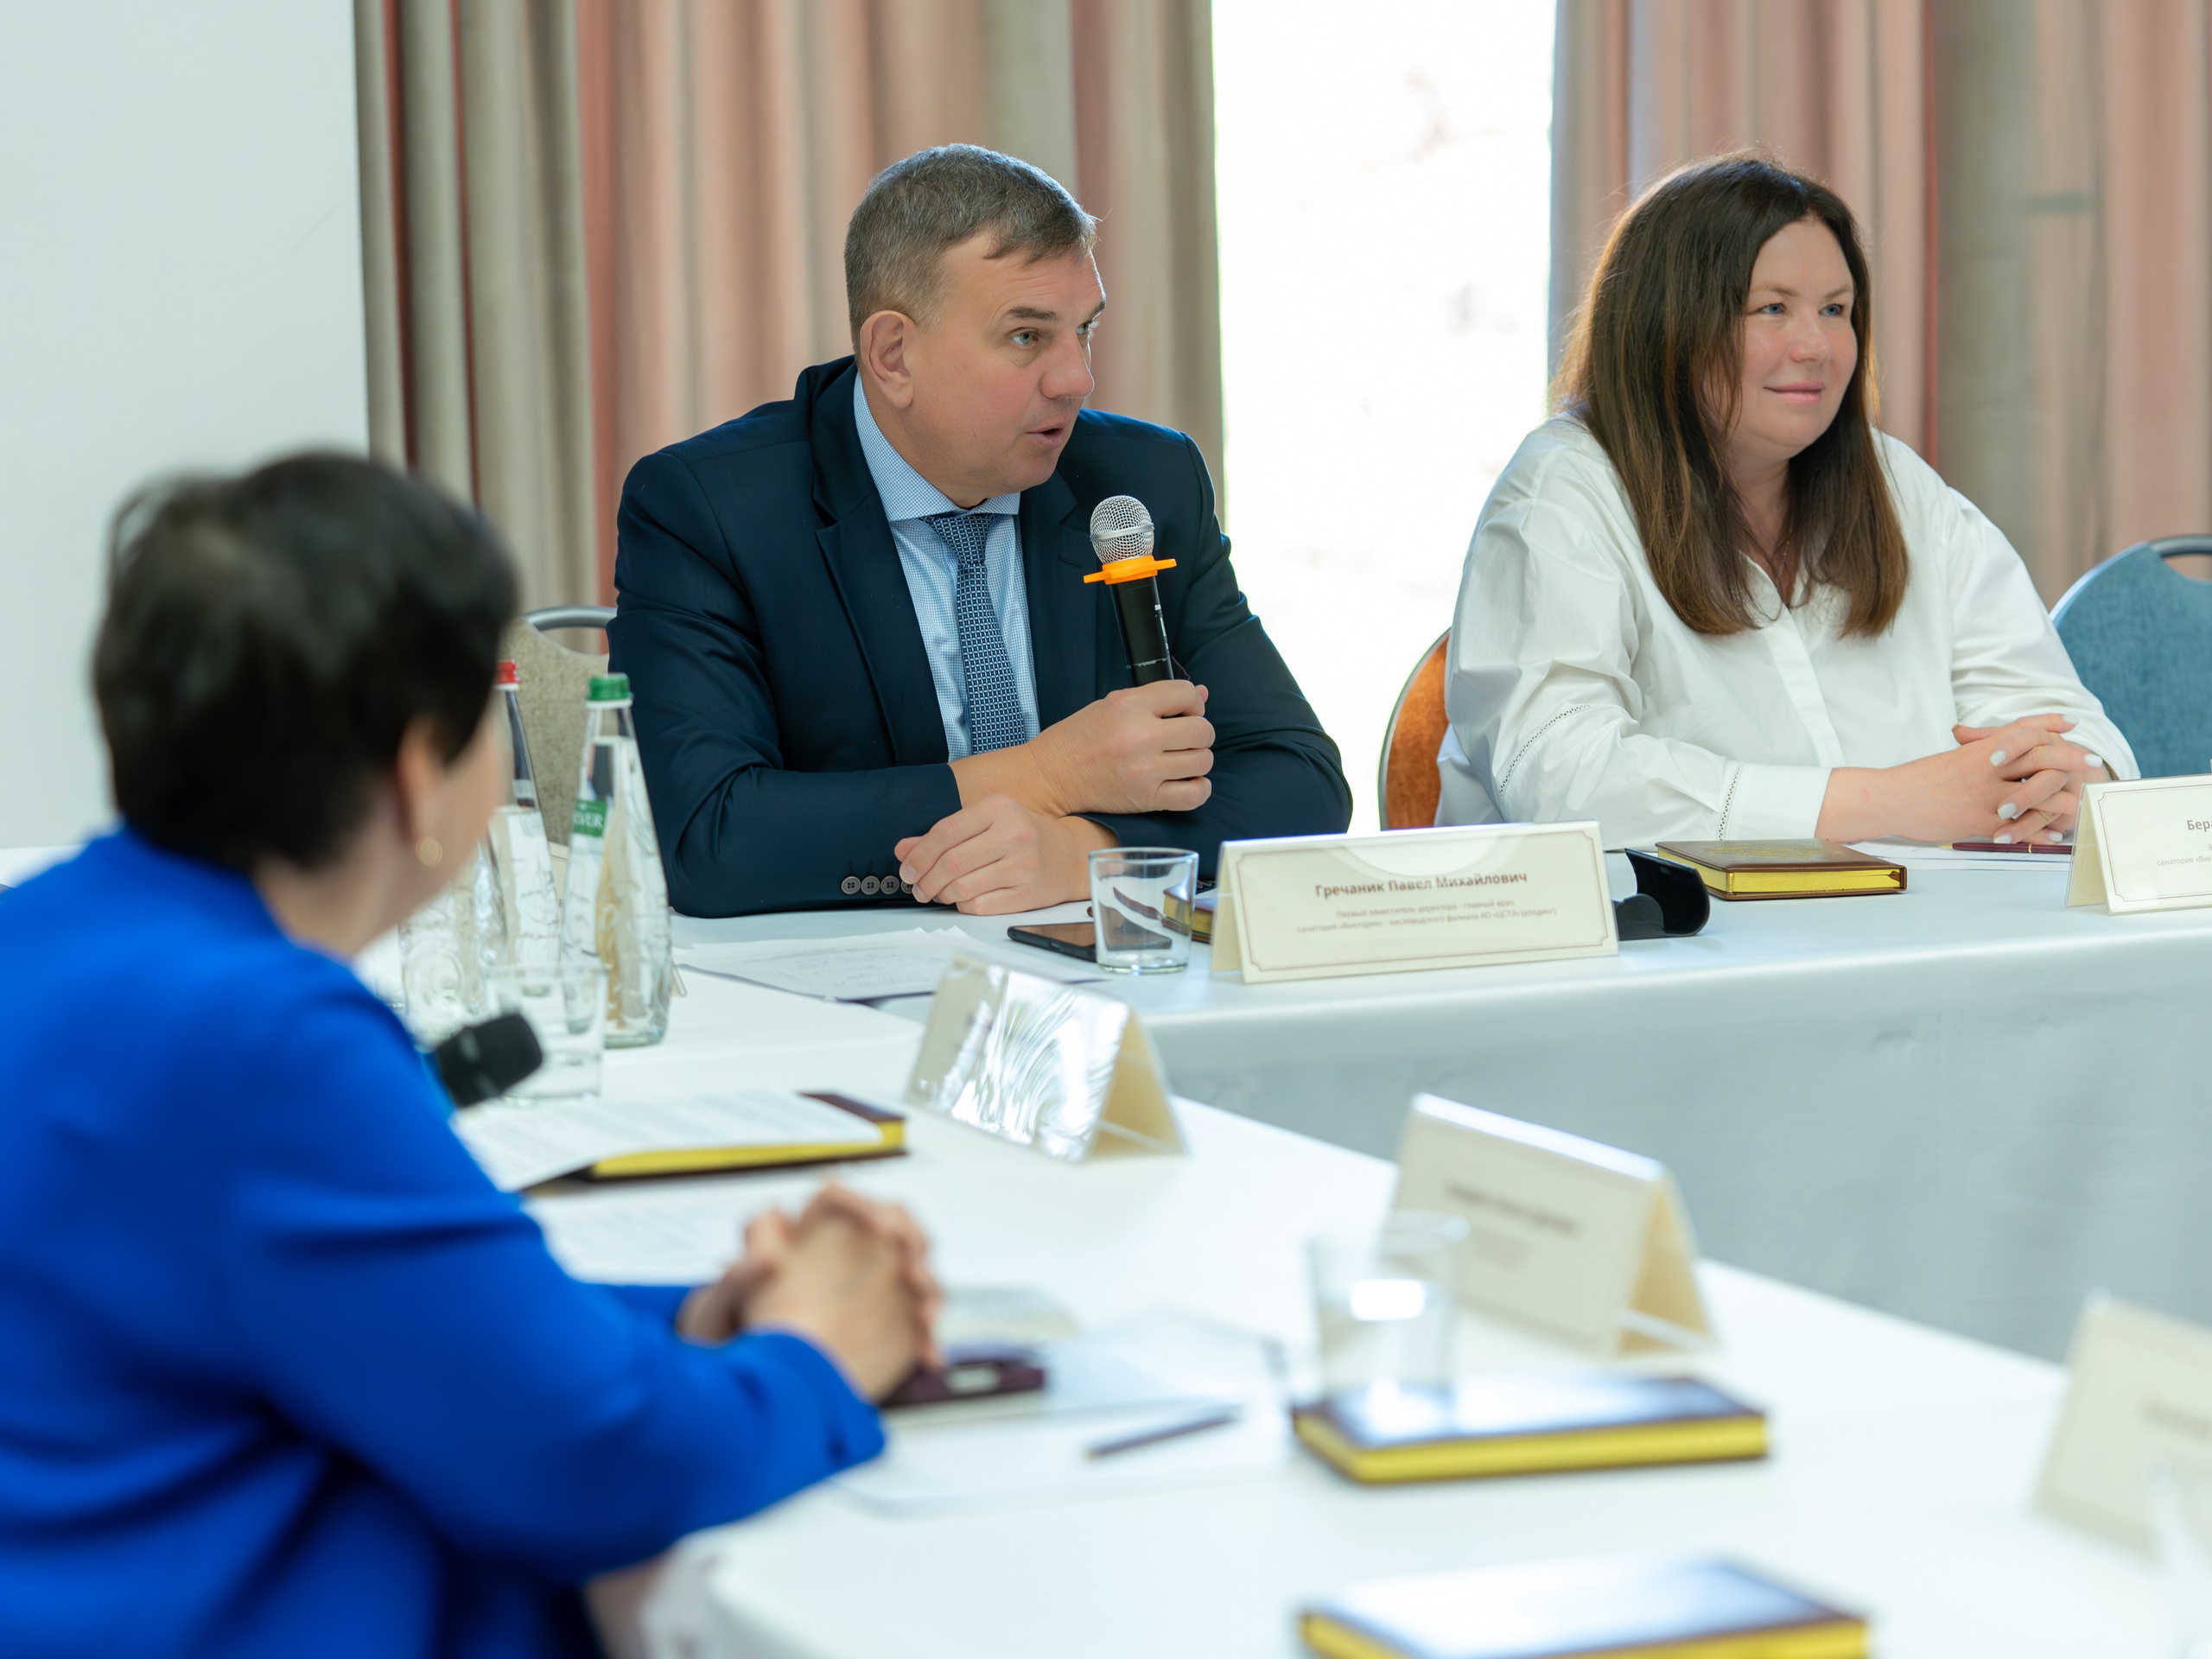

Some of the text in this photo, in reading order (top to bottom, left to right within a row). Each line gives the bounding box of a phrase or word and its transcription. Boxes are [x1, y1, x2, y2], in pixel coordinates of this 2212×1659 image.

[2186, 819, 2212, 832] Бер
[2157, 855, 2212, 866] санатория «Вик
[1315, 873, 1528, 899] Гречаник Павел Михайлович
[1337, 908, 1368, 918] Первый
[1370, 906, 1416, 916] заместитель
[1418, 903, 1458, 913] директора
[1464, 899, 1496, 909] главный
[1497, 899, 1515, 908] врач
[1298, 924, 1338, 933] санатория
[1339, 920, 1383, 930] «Виктория»
[1389, 915, 1446, 926] кисловодского
[1446, 912, 1478, 923] филиала
[1522, 906, 1557, 918] (холдинг)
